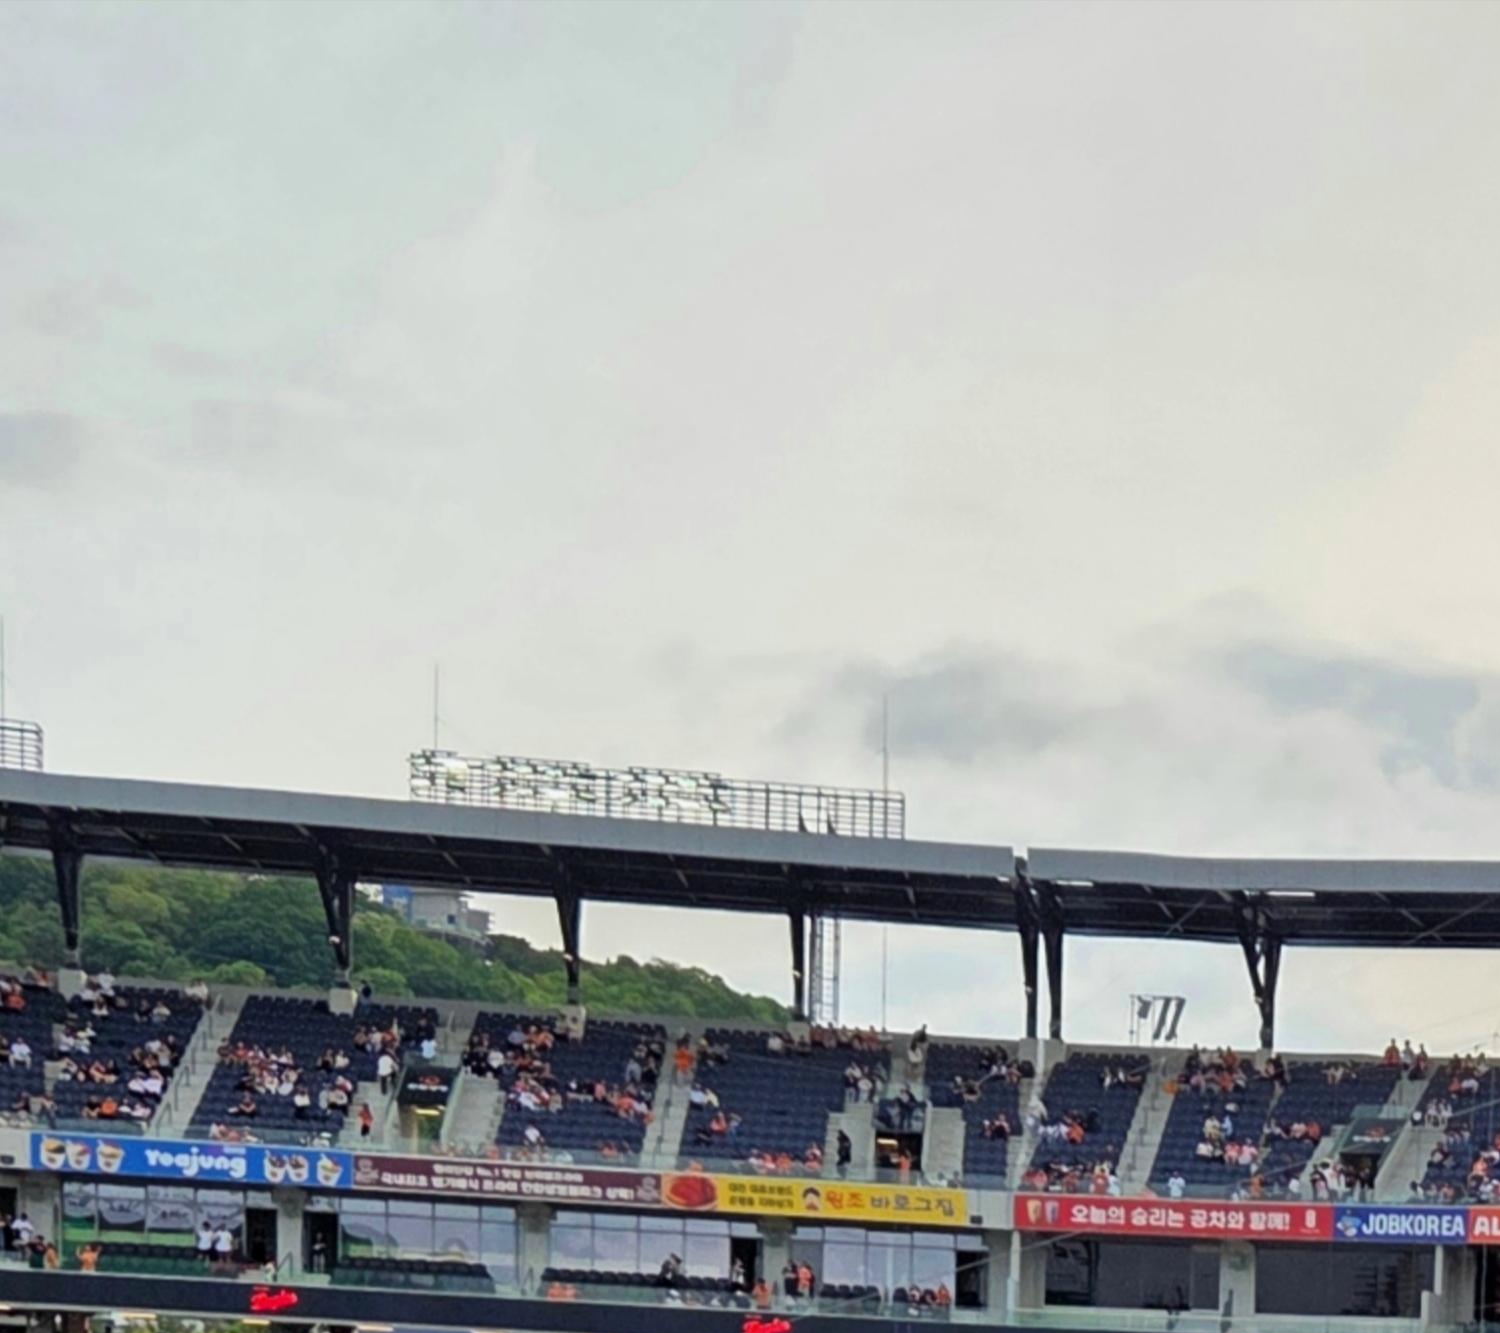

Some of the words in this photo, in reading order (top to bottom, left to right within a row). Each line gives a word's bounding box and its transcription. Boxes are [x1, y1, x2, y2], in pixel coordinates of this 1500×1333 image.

[826, 1190, 866, 1210] 원조
[1071, 1205, 1125, 1225] 오늘의
[1130, 1207, 1185, 1228] 승리는
[1190, 1208, 1246, 1230] 공차와
[1249, 1211, 1291, 1232] 함께!
[1361, 1212, 1465, 1237] JOBKOREA
